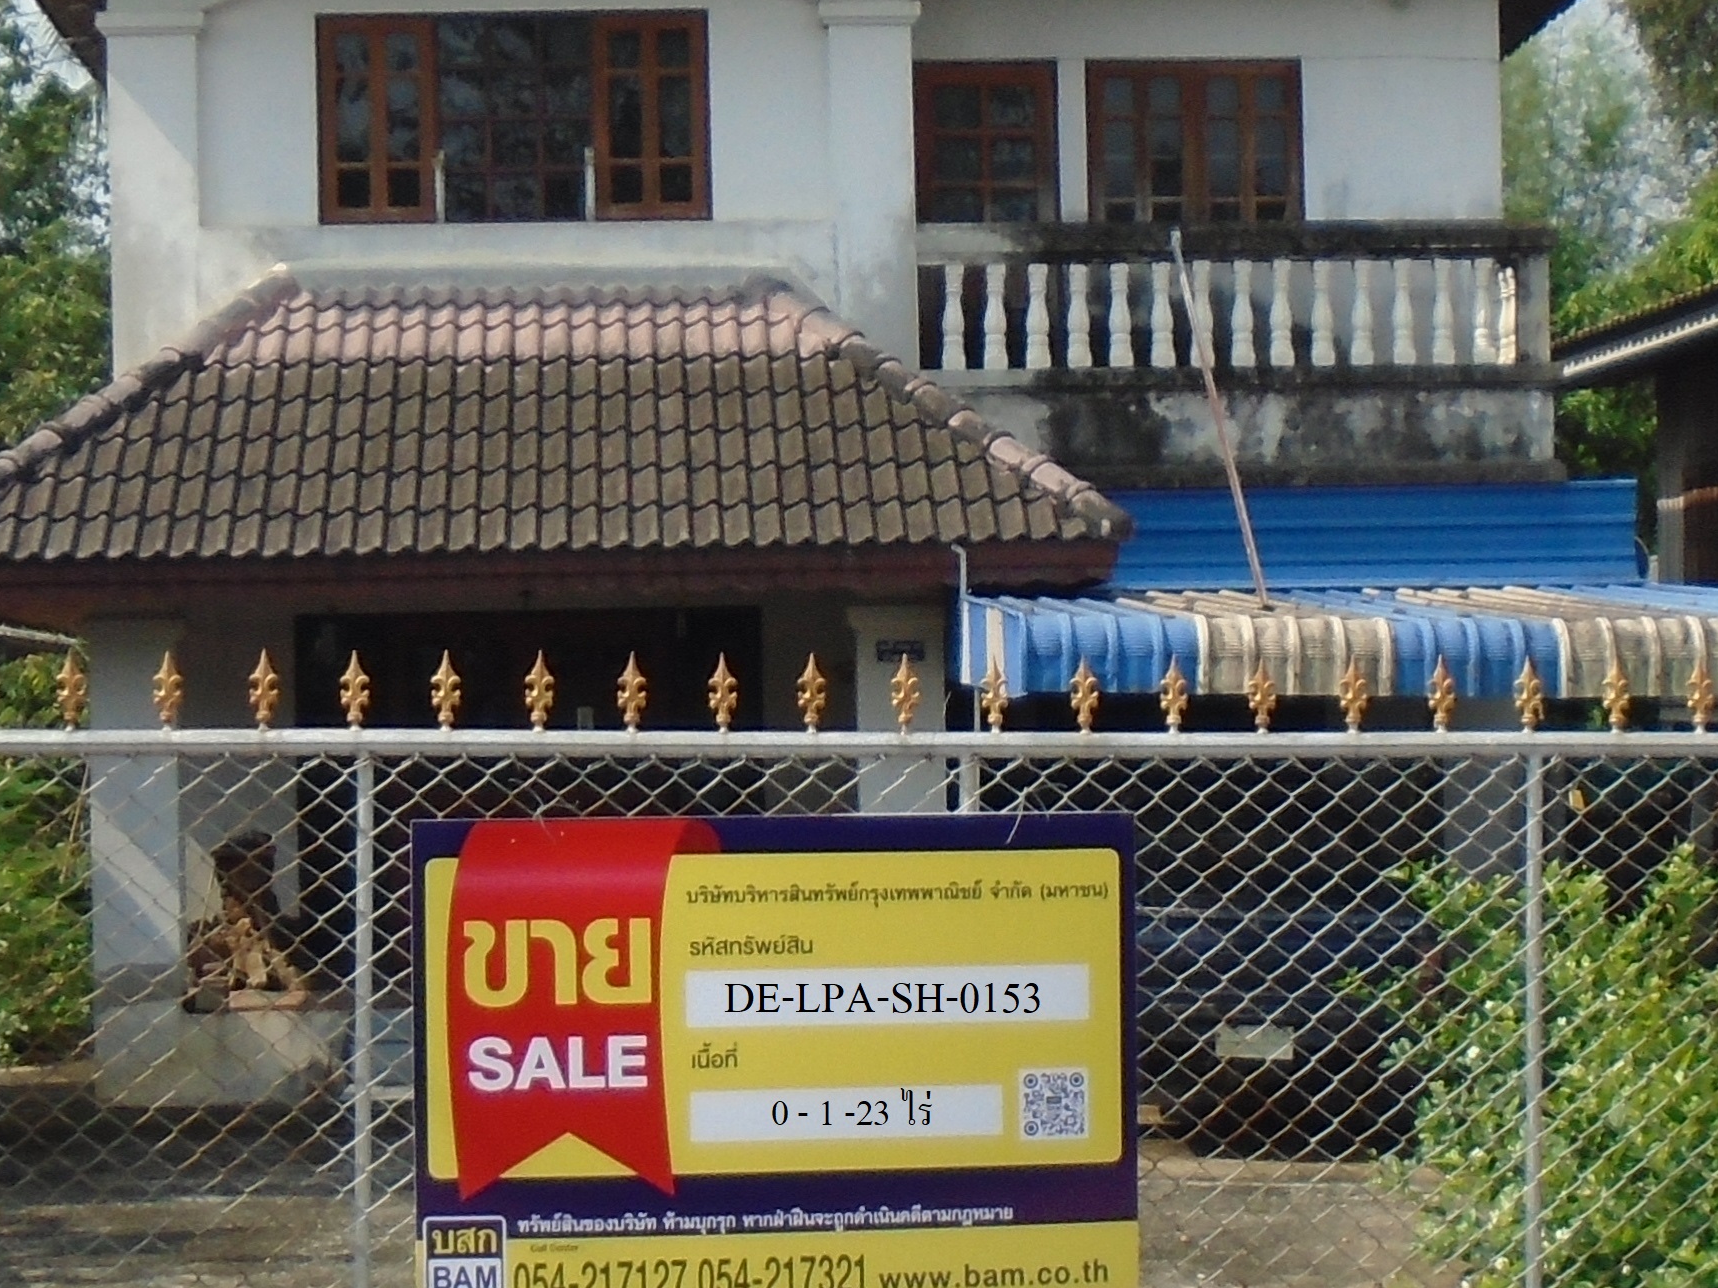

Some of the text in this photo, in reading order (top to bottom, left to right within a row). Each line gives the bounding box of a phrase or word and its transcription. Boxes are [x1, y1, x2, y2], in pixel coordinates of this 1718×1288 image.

[686, 879, 1110, 909] บริษัทบริหารสินทรัพย์กรุงเทพพาณิชย์ จำกัด (มหาชน)
[689, 933, 814, 956] รหัสทรัพย์สิน
[463, 917, 652, 1008] ขาย
[467, 1035, 649, 1092] SALE
[690, 1042, 739, 1070] เนื้อที่
[516, 1211, 657, 1233] ทรัพย์สินของบริษัท
[662, 1210, 737, 1235] ห้ามบุกรุก
[431, 1226, 498, 1255] บสก
